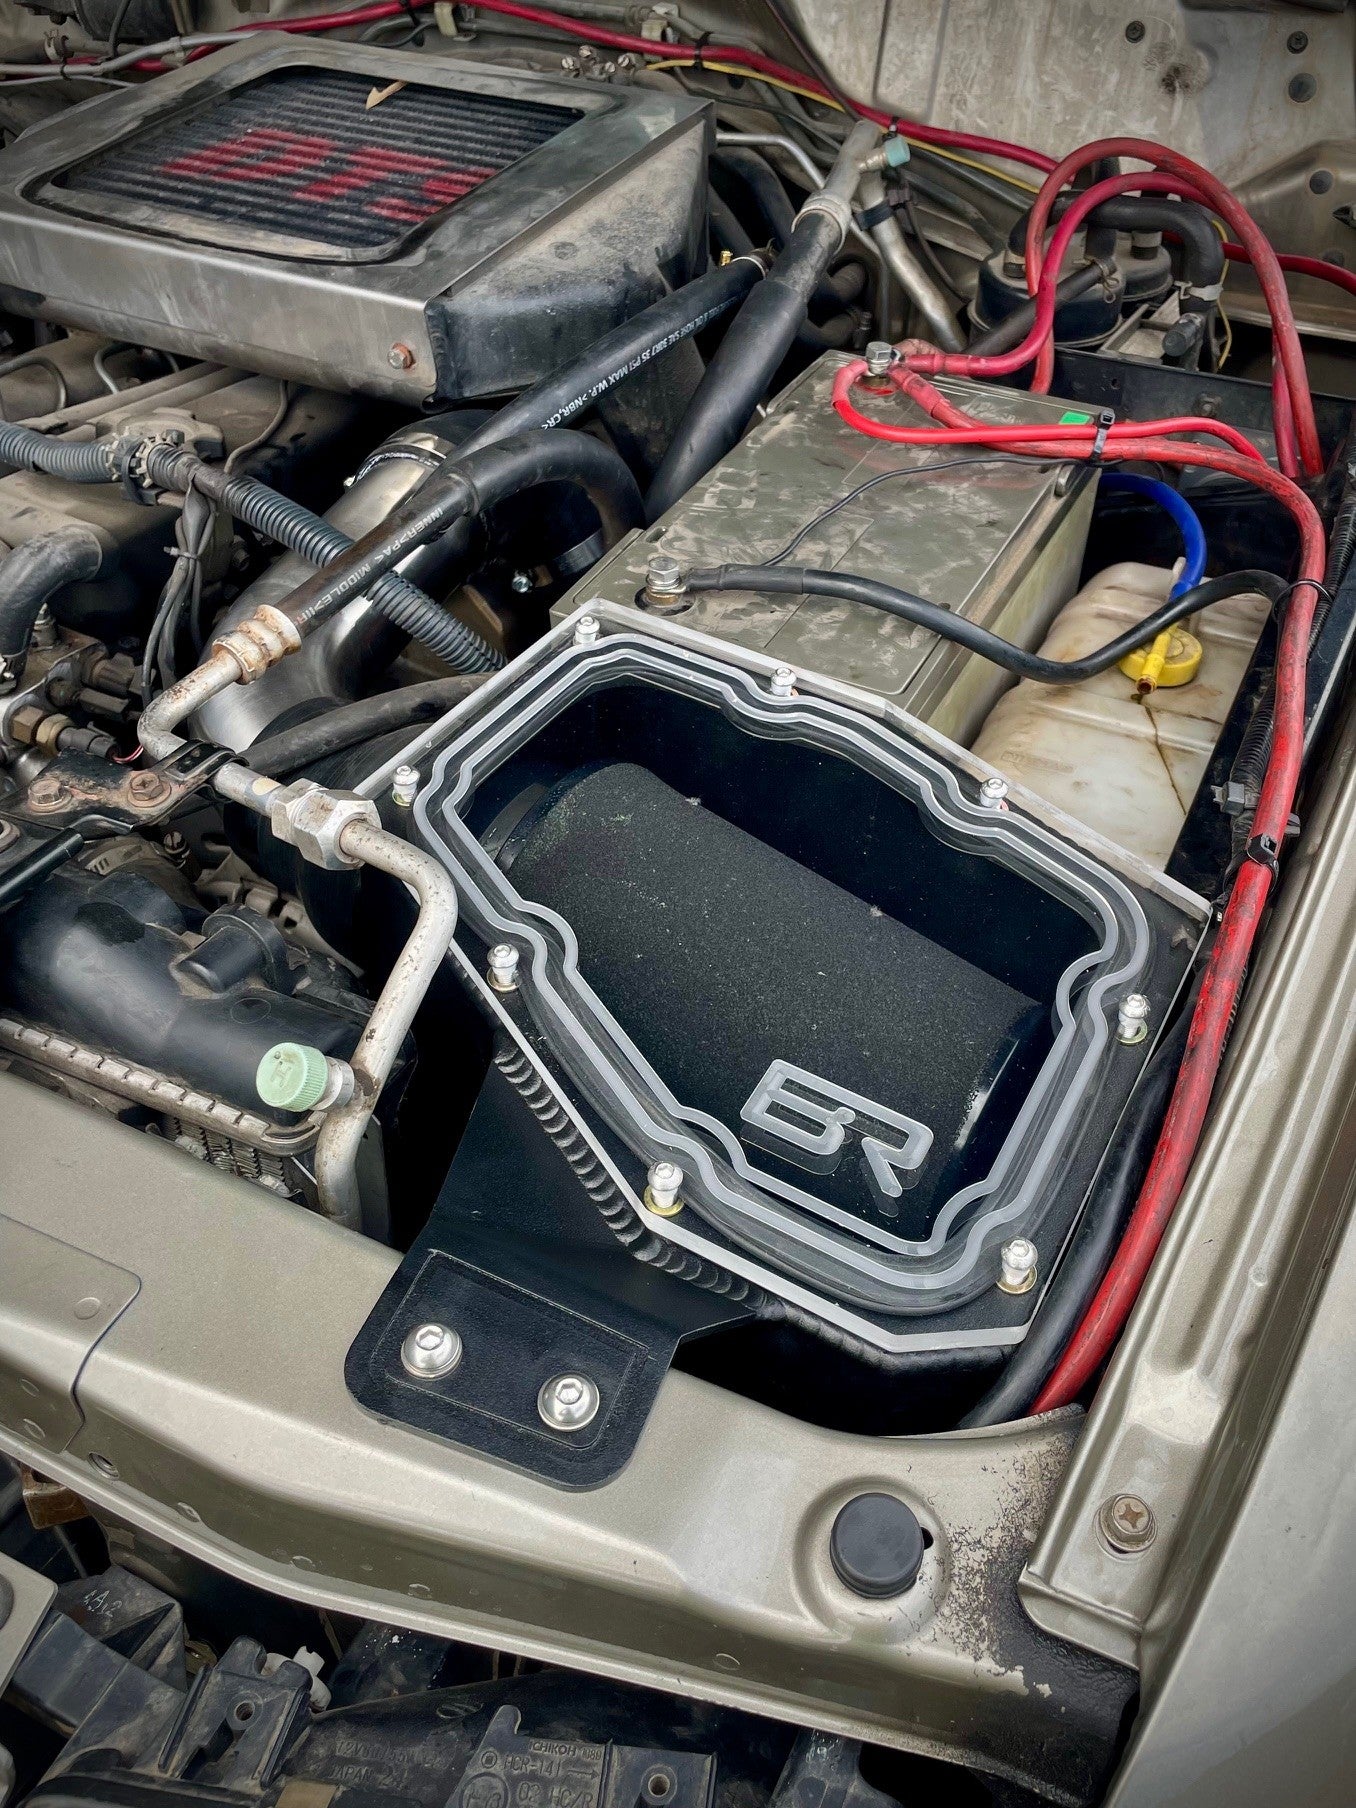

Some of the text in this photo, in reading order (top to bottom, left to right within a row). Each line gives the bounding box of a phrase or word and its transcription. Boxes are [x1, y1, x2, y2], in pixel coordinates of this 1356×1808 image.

[628, 356, 642, 372] PSI
[641, 349, 652, 363] 35
[608, 364, 629, 386] MAX
[588, 379, 609, 398] W.P.
[541, 393, 588, 430] >NBR,CR<
